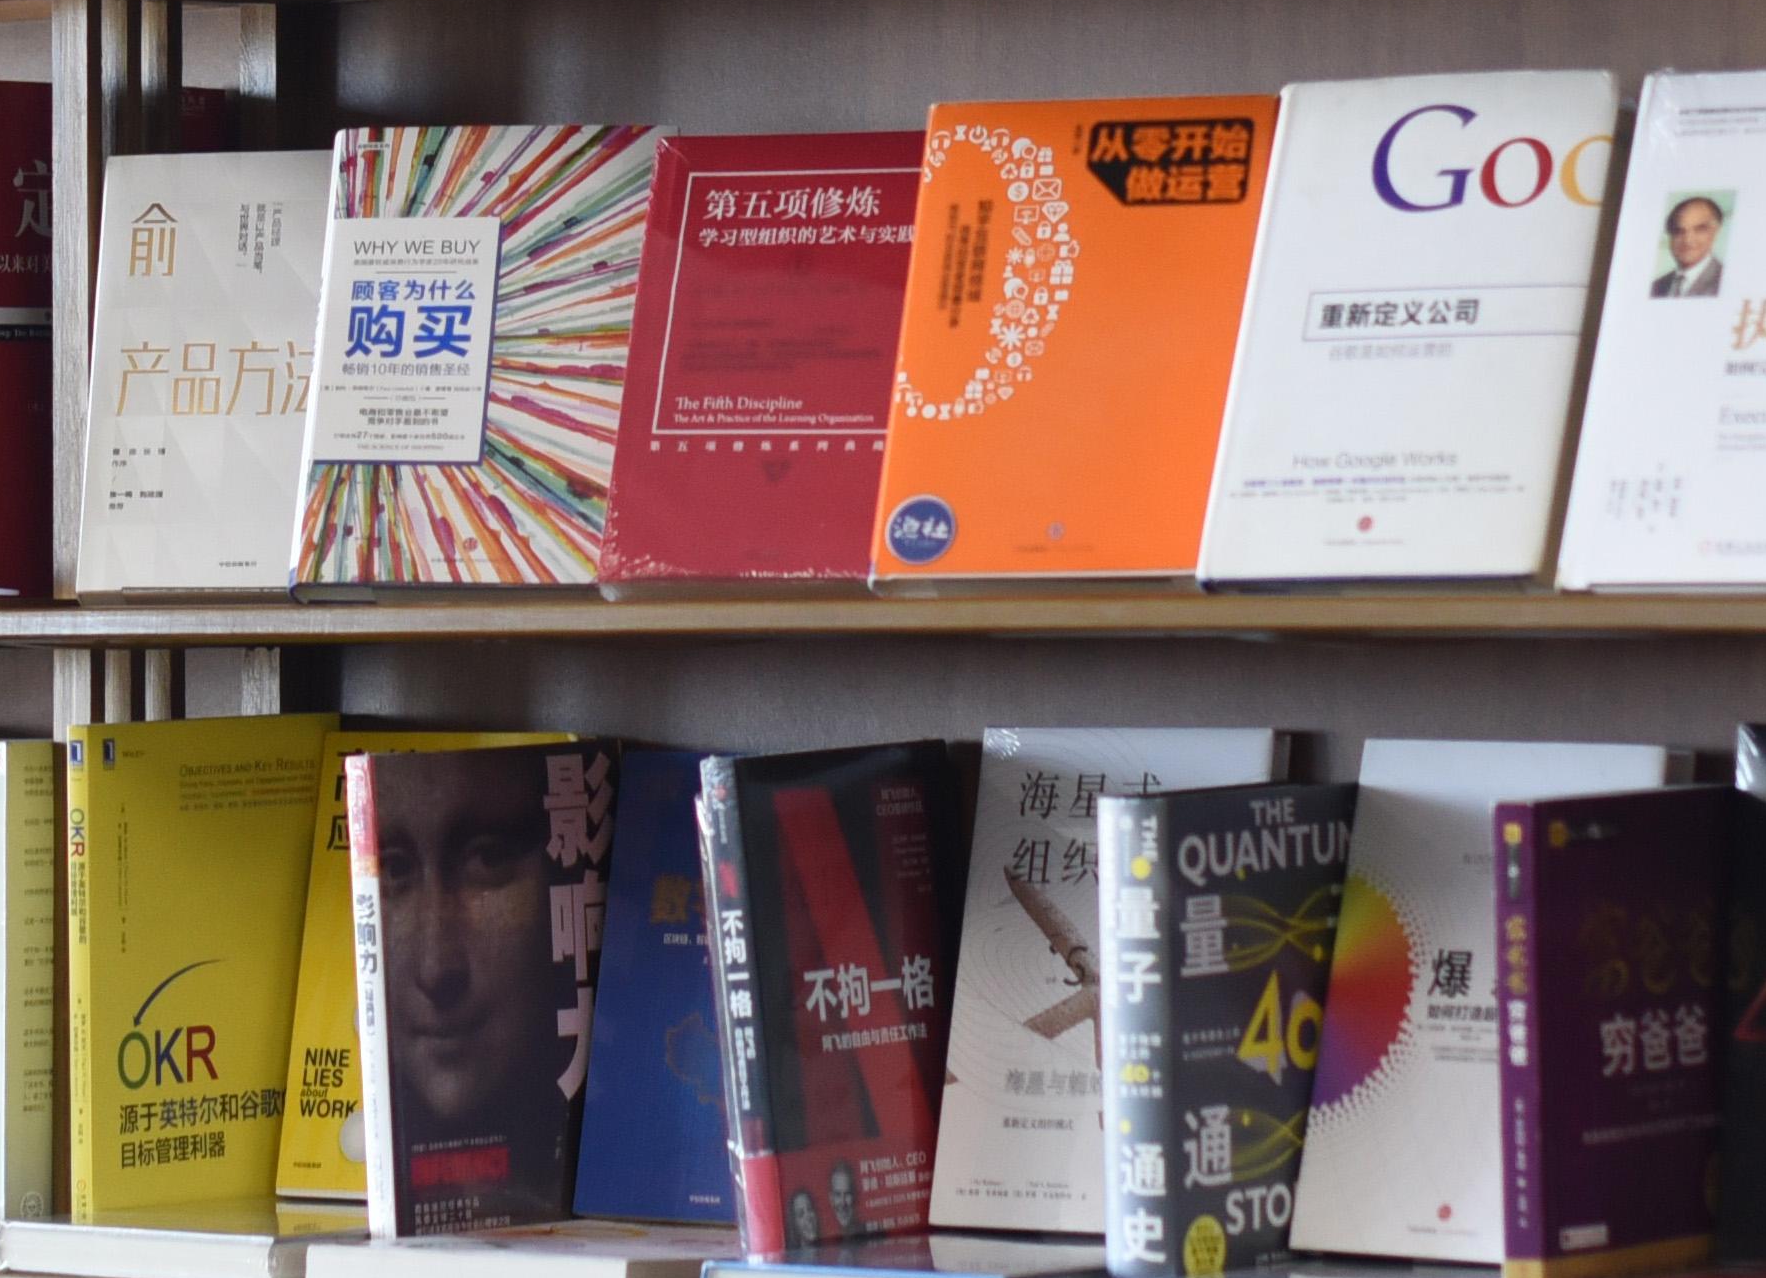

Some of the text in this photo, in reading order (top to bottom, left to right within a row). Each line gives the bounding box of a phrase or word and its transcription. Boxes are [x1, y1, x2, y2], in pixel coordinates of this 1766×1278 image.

[1092, 124, 1250, 161] 从零开始
[1125, 164, 1248, 201] 做运营
[703, 189, 882, 220] 第五项修炼
[128, 201, 180, 278] 俞
[353, 239, 481, 255] WHY WE BUY
[699, 225, 916, 247] 学习型组织的艺术与实践
[351, 279, 475, 302] 顾客为什么
[345, 304, 473, 359] 购买
[1319, 299, 1480, 329] 重新定义公司
[342, 363, 471, 377] 畅销10年的销售圣经
[675, 396, 803, 414] The Fifth Discipline
[1293, 449, 1458, 471] How Google Works
[1250, 799, 1295, 827] THE
[69, 807, 86, 858] OKR
[356, 892, 378, 976] 影响力
[1180, 894, 1230, 978] 量
[721, 909, 754, 1020] 不拘一格
[803, 953, 936, 1023] 不拘一格
[1238, 969, 1324, 1086] 40
[1601, 1001, 1709, 1079] 穷爸爸
[117, 1024, 219, 1090] OKR
[304, 1048, 351, 1068] NINE
[299, 1086, 329, 1099] about
[302, 1067, 344, 1088] LIES
[299, 1099, 359, 1119] WORK
[121, 1131, 225, 1169] 目标管理利器
[1183, 1104, 1233, 1189] 通
[1119, 1144, 1167, 1264] 通史
